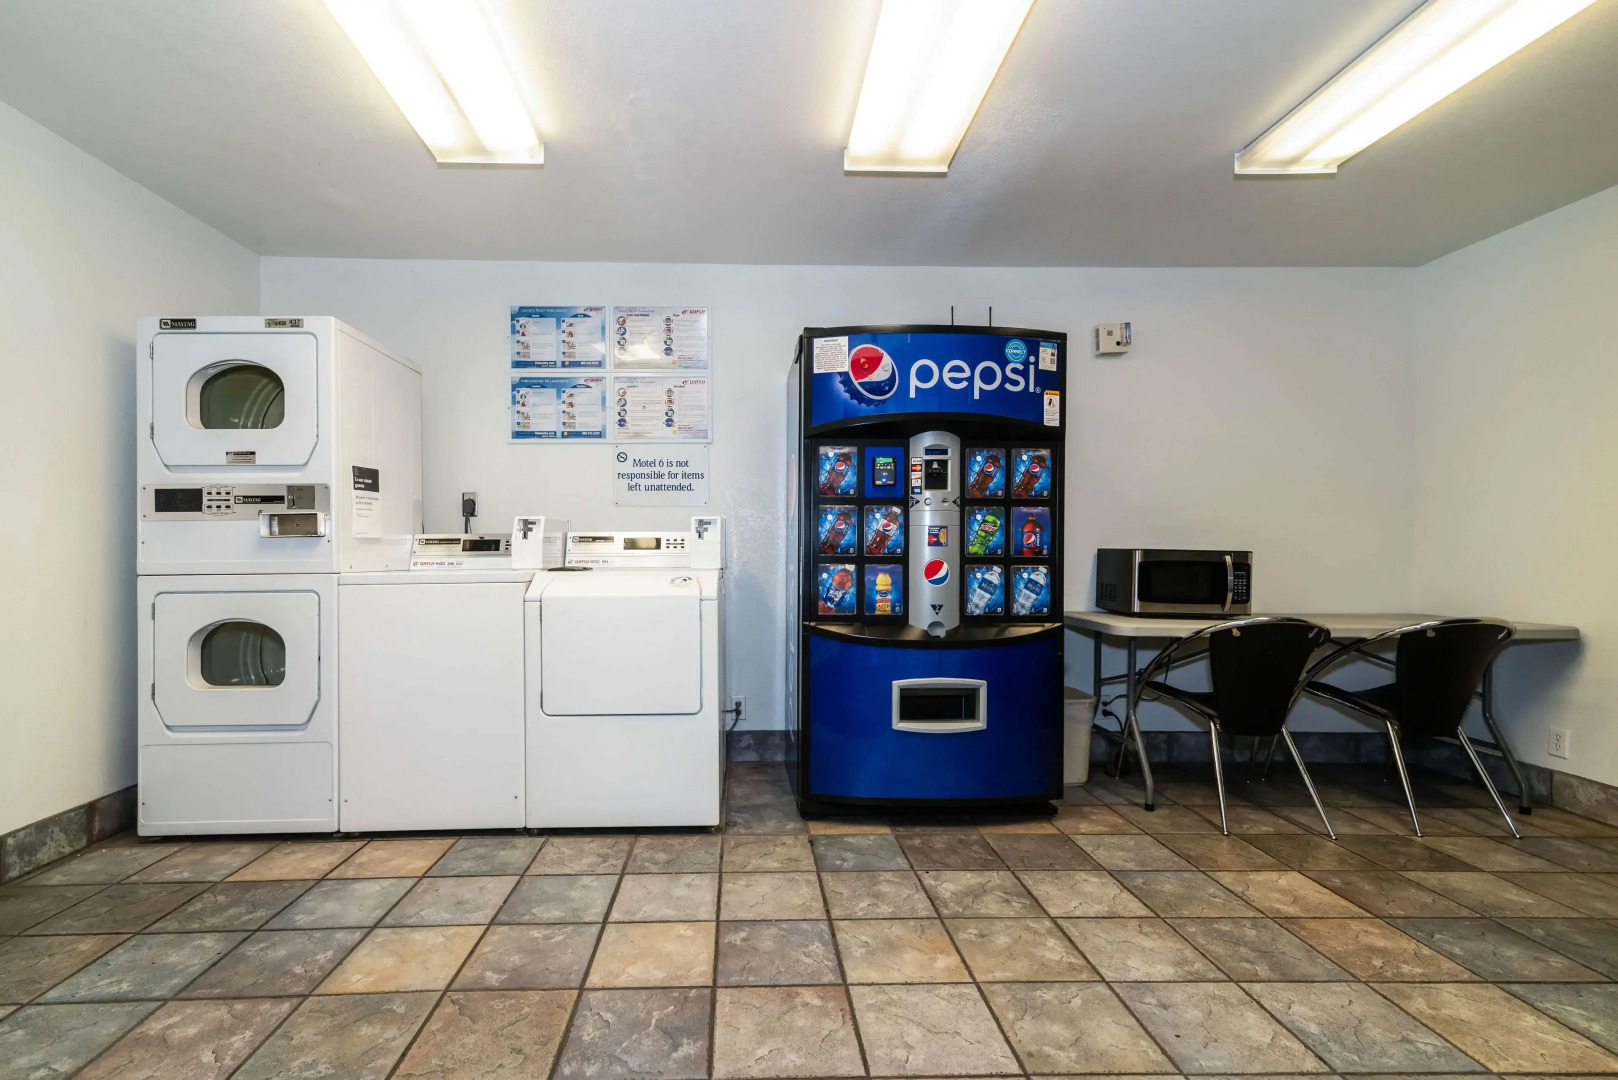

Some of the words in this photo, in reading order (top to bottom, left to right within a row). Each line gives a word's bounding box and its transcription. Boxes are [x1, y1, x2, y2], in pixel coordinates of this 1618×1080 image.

[909, 355, 1035, 400] pepsi
[632, 458, 657, 468] Motel
[658, 458, 665, 468] 6
[666, 458, 674, 468] is
[675, 459, 689, 468] not
[617, 470, 666, 482] responsible
[667, 470, 680, 480] for
[681, 470, 705, 480] items
[627, 482, 642, 492] left
[644, 482, 695, 492] unattended.
